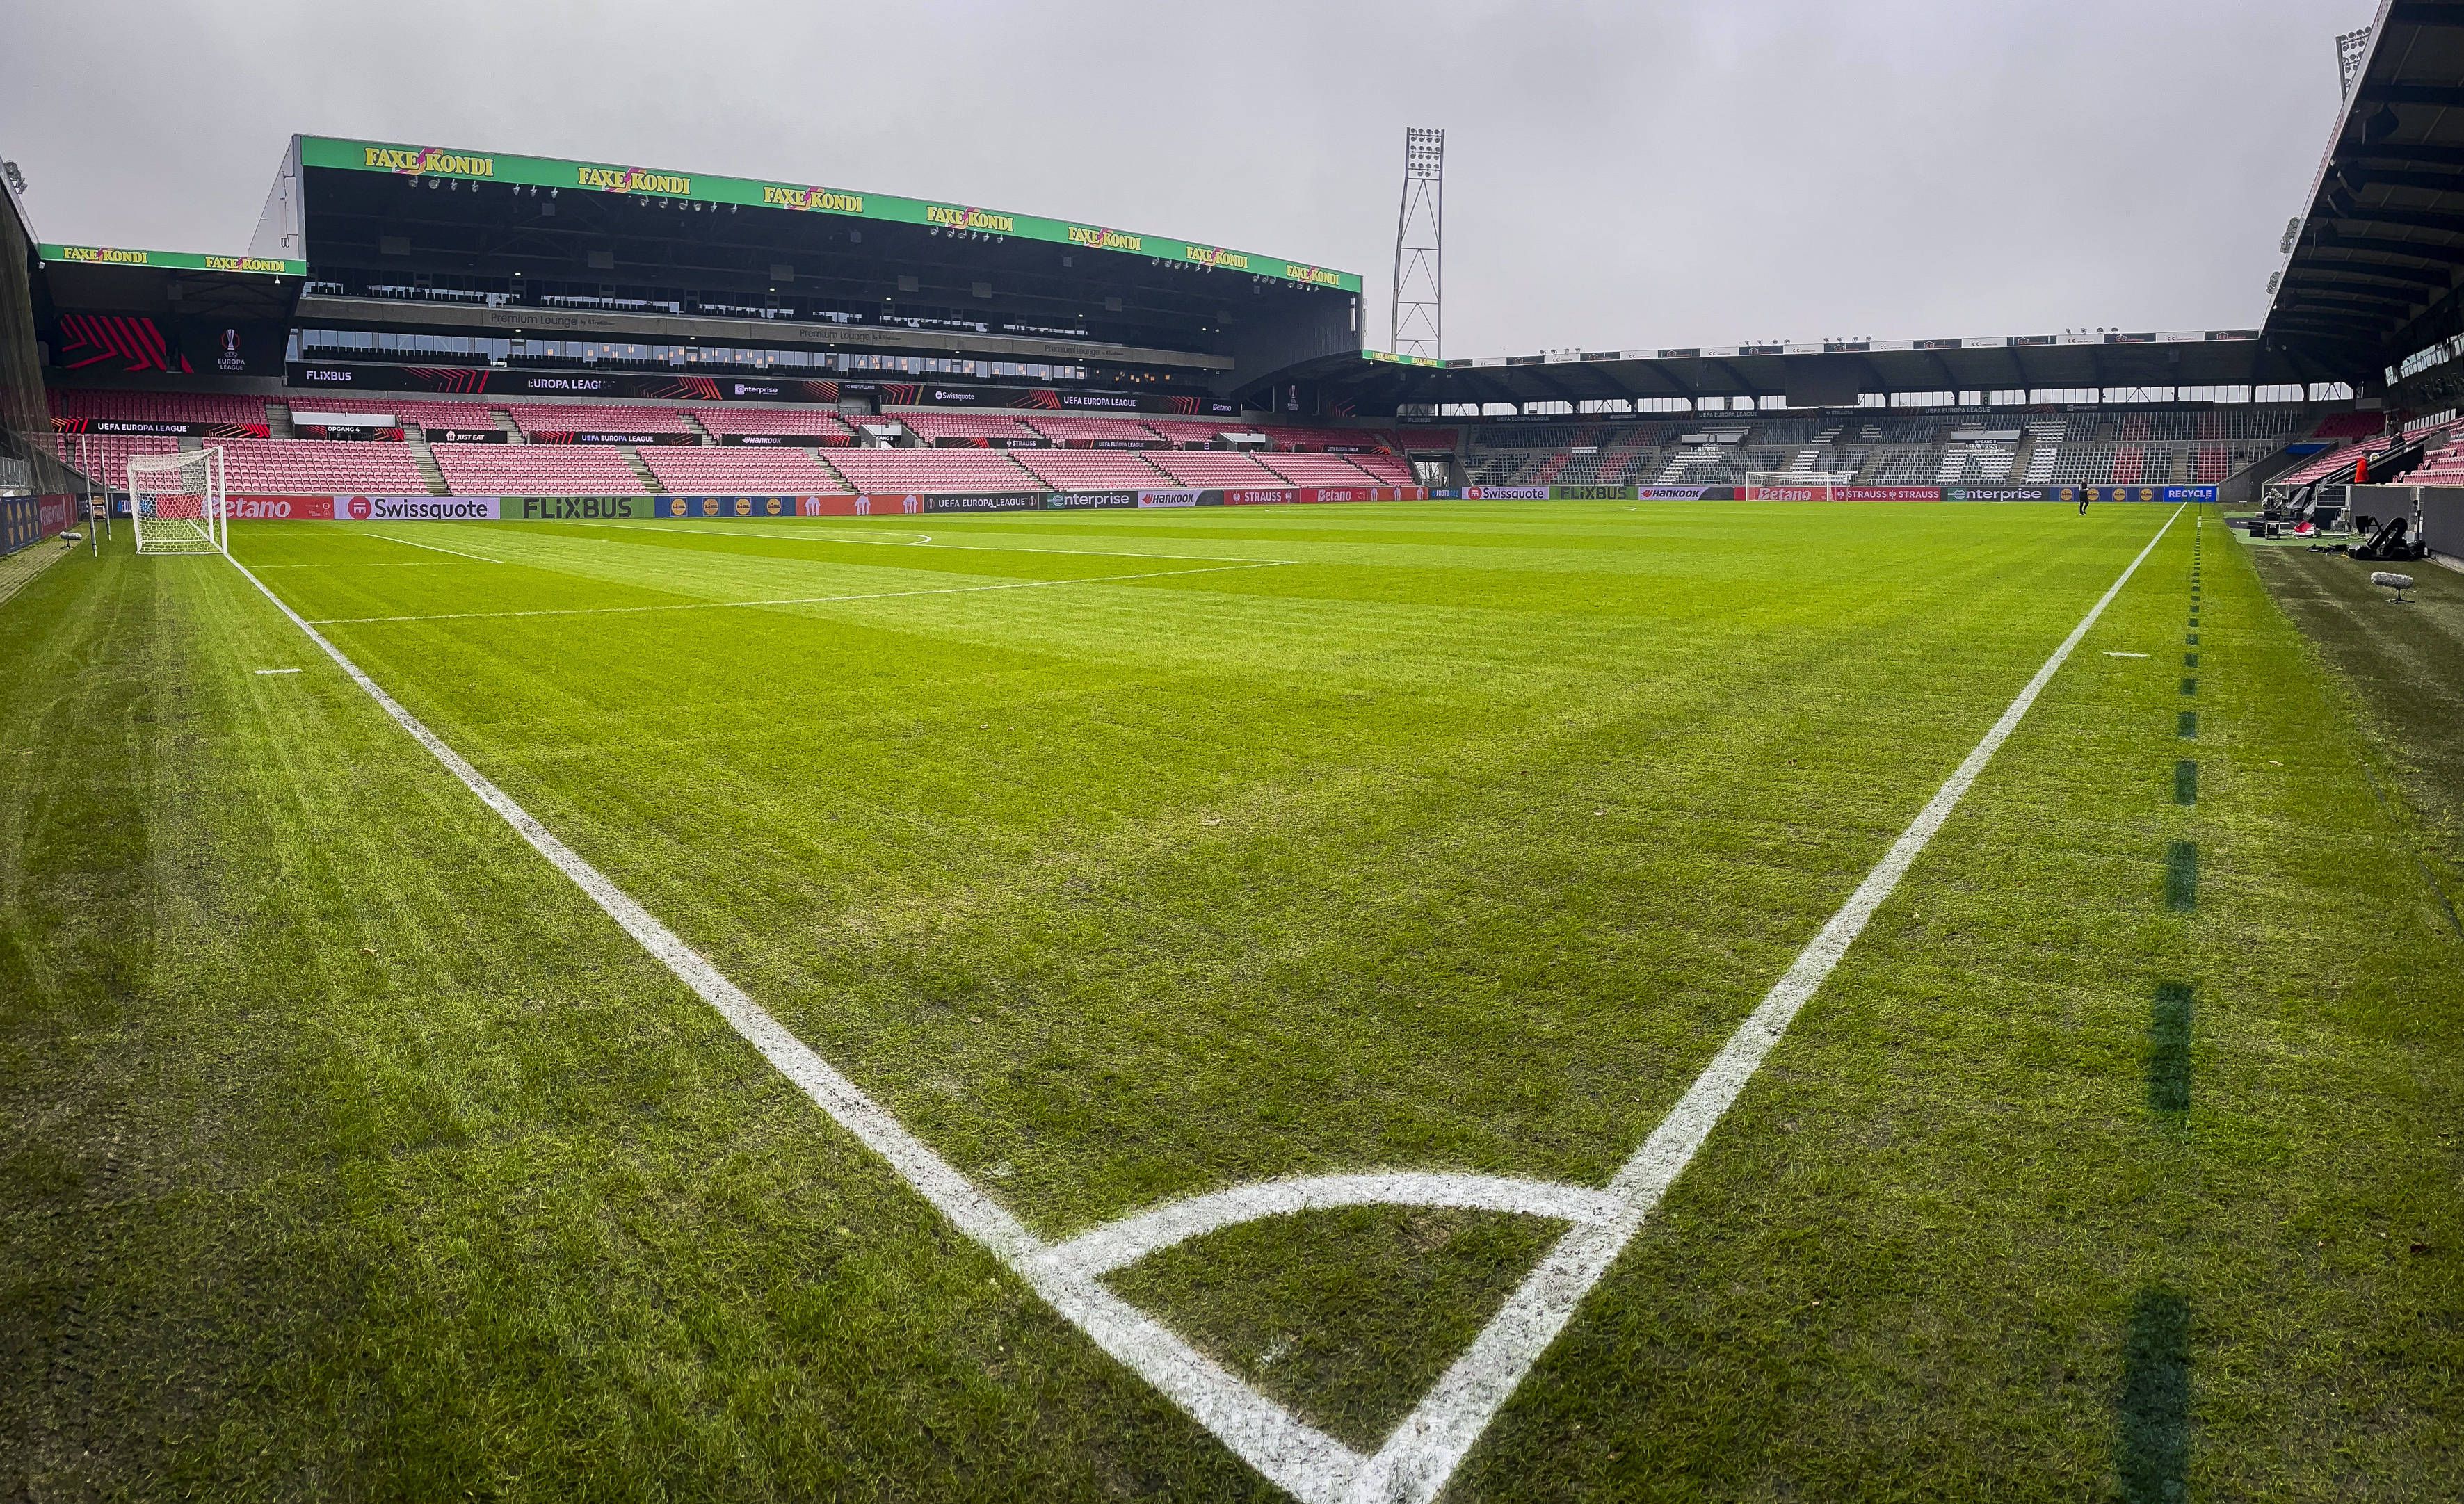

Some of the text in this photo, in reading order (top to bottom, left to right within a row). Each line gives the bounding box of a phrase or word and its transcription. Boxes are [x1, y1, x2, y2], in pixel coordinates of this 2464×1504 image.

[364, 147, 494, 176] FAXE KONDI
[578, 168, 691, 195] FAXE KONDI
[764, 187, 863, 213] FAXE KONDI
[926, 206, 1013, 232] FAXE KONDI
[1068, 227, 1141, 251] FAXE KONDI
[63, 248, 147, 264] FAXE KONDI
[1186, 246, 1248, 268] FAXE KONDI
[205, 257, 285, 272] FAXE KONDI
[1287, 264, 1339, 285] FAXE KONDI
[491, 314, 538, 324] Premium
[541, 315, 577, 328] Lounge
[800, 329, 839, 339] Premium
[840, 331, 870, 342] Lounge
[1045, 345, 1075, 355] Premium
[529, 379, 570, 389] EUROPA
[735, 384, 778, 395] enterprise
[942, 392, 975, 401] Swissquote
[1063, 396, 1136, 407] UEFA EUROPA LEAGUE
[1983, 397, 1988, 405] 8
[1051, 492, 1129, 508] enterprise
[1244, 492, 1282, 502] STRAUSS
[1317, 489, 1352, 502] Betano
[1483, 488, 1544, 500] Swissquote
[1757, 488, 1812, 501] Betano
[1952, 488, 2043, 501] enterprise
[200, 496, 291, 518] Betano
[374, 498, 488, 519] Swissquote
[523, 498, 631, 518] FLiXBUS
[938, 498, 1025, 508] UEFA EUROPA LEAGUE
